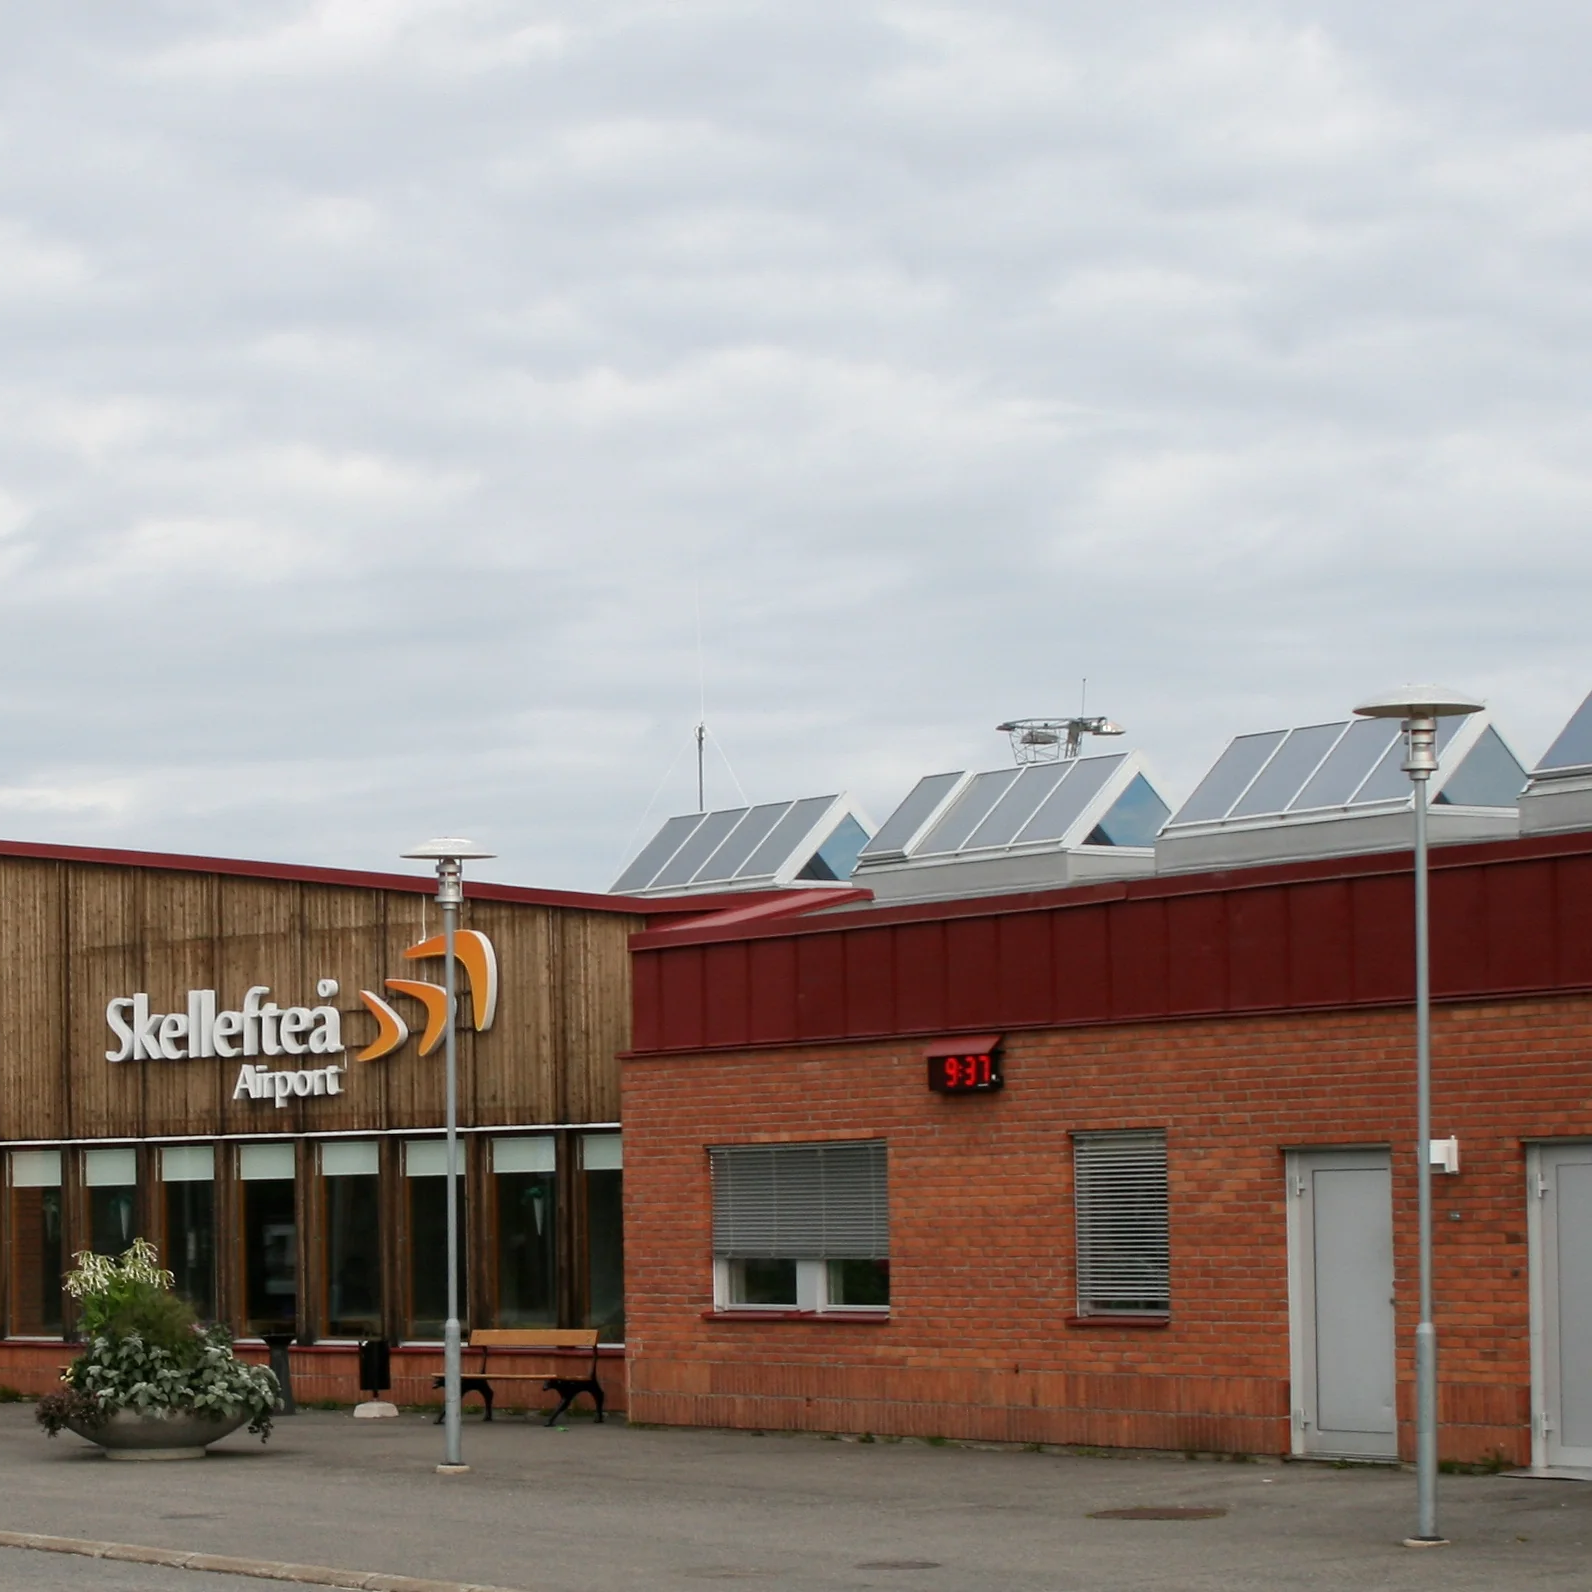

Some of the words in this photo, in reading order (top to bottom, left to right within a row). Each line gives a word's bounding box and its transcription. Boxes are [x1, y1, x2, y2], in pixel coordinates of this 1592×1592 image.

[105, 979, 344, 1062] Skellefteå
[233, 1064, 344, 1108] Airport
[944, 1055, 991, 1088] 9:37
